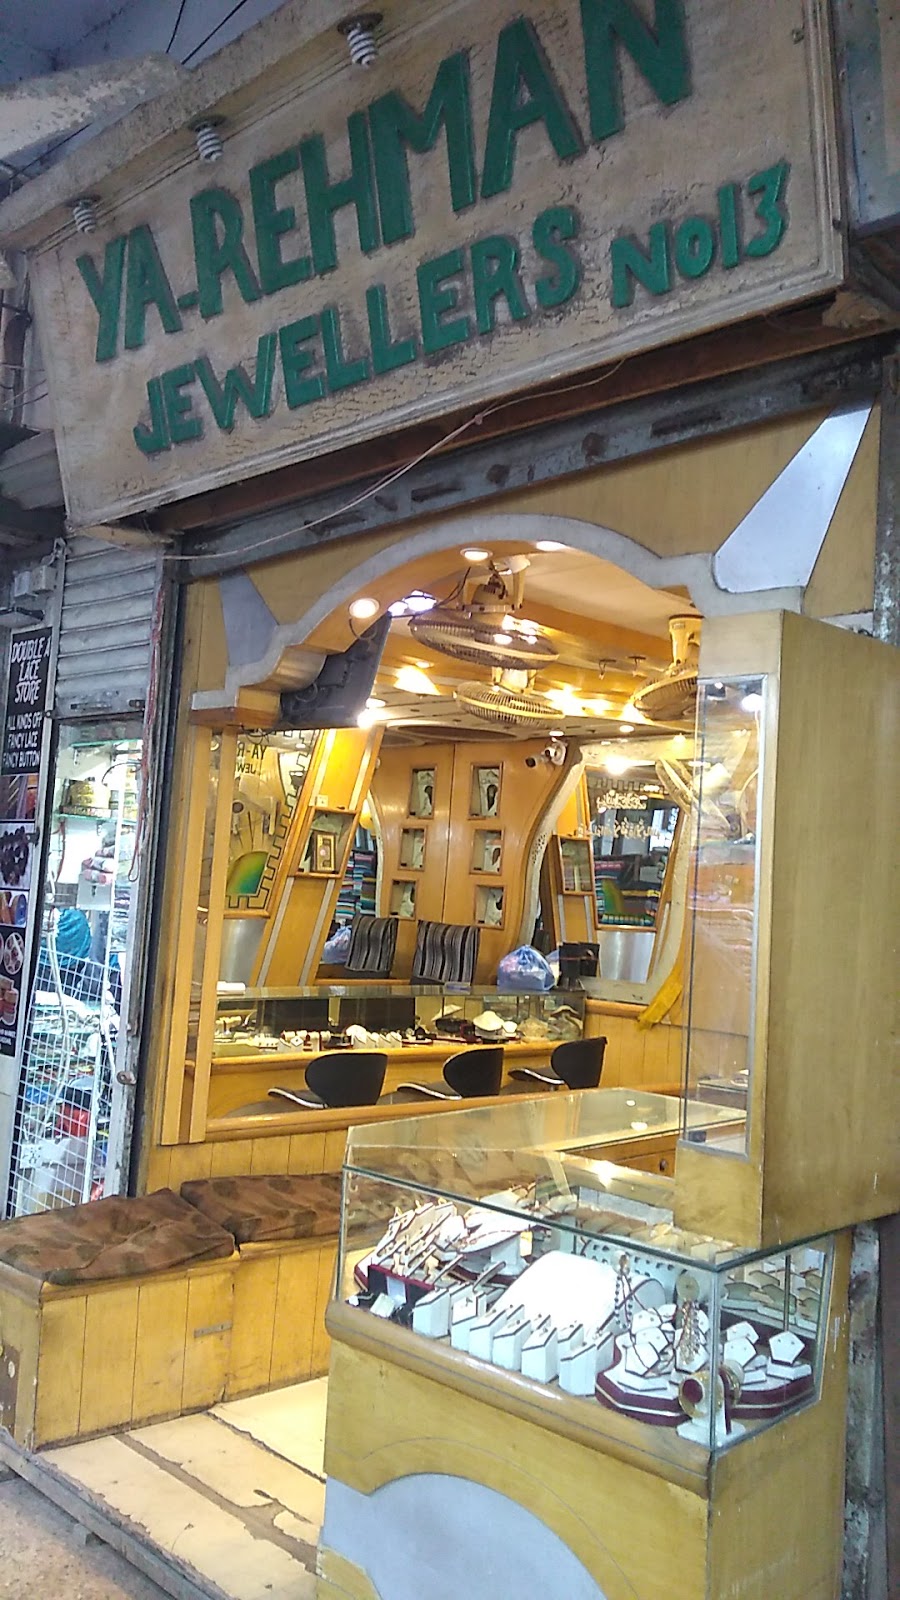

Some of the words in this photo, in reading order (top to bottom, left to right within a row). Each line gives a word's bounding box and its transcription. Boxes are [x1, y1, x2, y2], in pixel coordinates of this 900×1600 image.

[133, 206, 583, 453] JEWELLERS
[11, 637, 45, 664] DOUBLE
[43, 634, 51, 657] A
[18, 659, 41, 682] LACE
[14, 679, 42, 706] STORE
[8, 732, 24, 749] FANCY
[25, 731, 38, 748] LACE
[3, 751, 19, 768] FANCY
[19, 750, 40, 767] BUTTON
